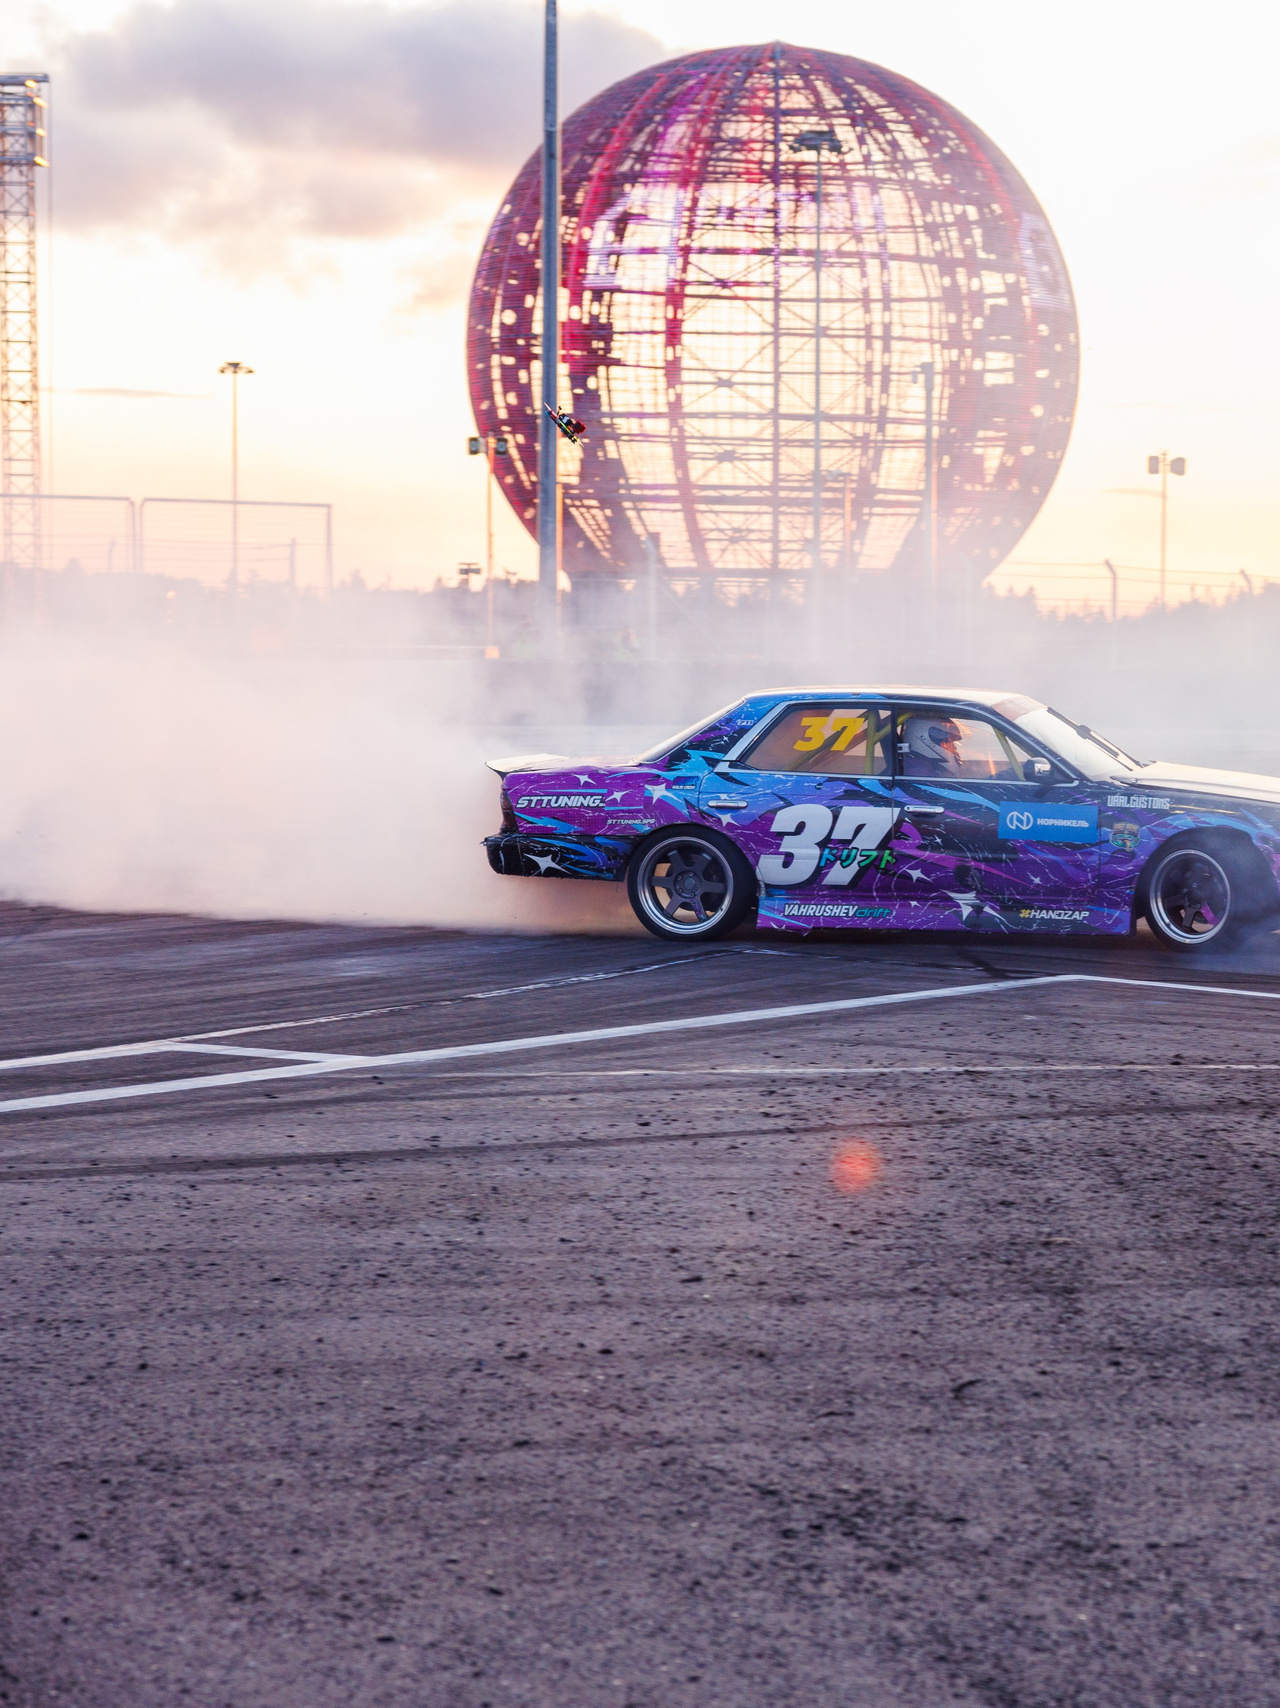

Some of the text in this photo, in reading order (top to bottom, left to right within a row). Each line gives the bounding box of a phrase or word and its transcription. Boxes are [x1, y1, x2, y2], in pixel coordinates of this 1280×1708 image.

[793, 716, 865, 751] 37
[1107, 795, 1171, 810] URALCUSTOMS
[1037, 818, 1090, 828] НОРНИКЕЛЬ
[756, 803, 901, 886] 37
[819, 847, 896, 869] ドリフト
